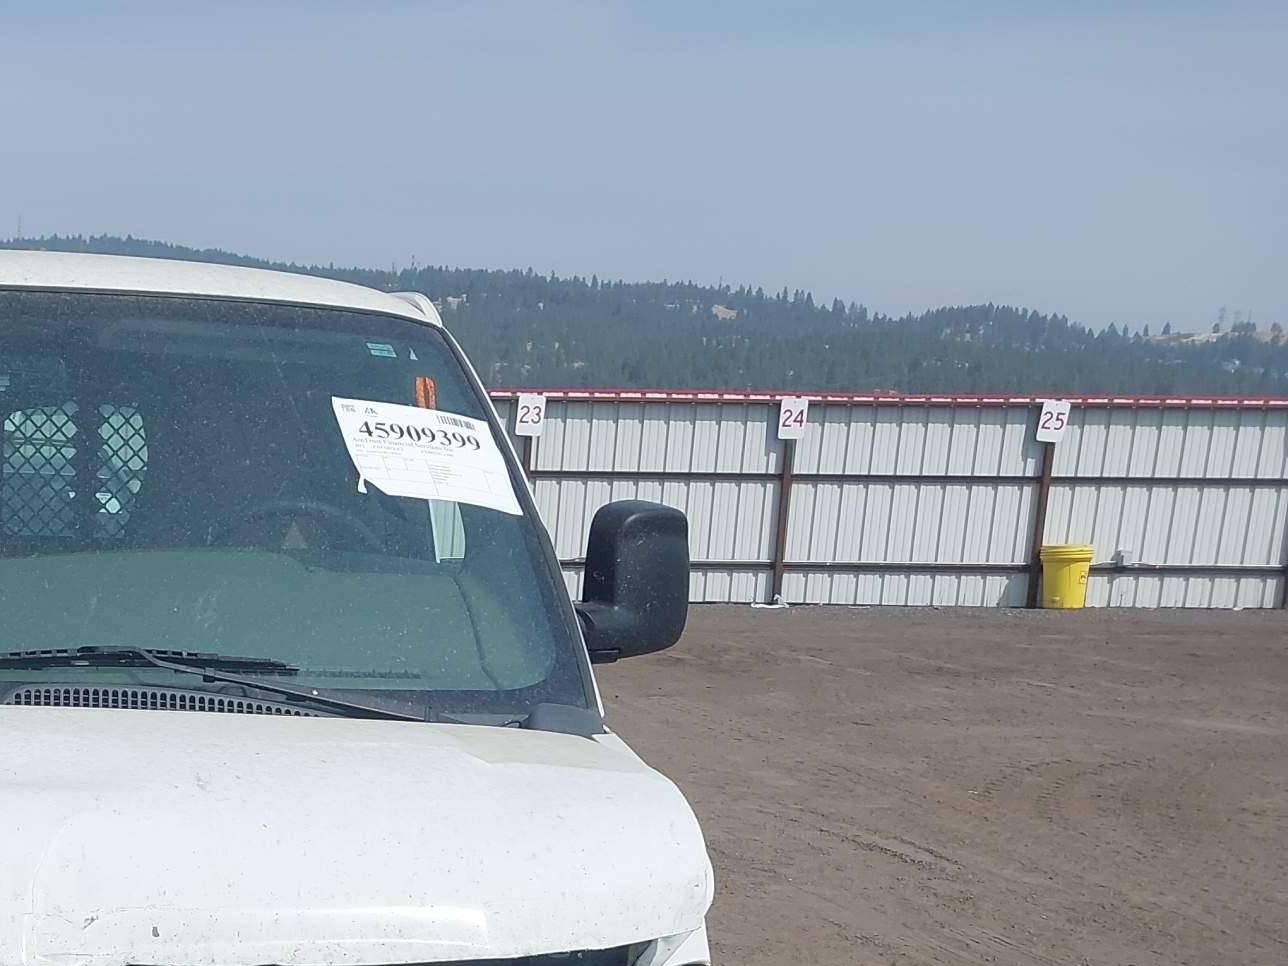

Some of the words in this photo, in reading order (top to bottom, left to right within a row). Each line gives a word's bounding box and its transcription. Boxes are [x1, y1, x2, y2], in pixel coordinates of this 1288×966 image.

[518, 405, 543, 424] 23
[781, 409, 805, 428] 24
[1041, 411, 1066, 431] 25
[358, 420, 481, 451] 45909399
